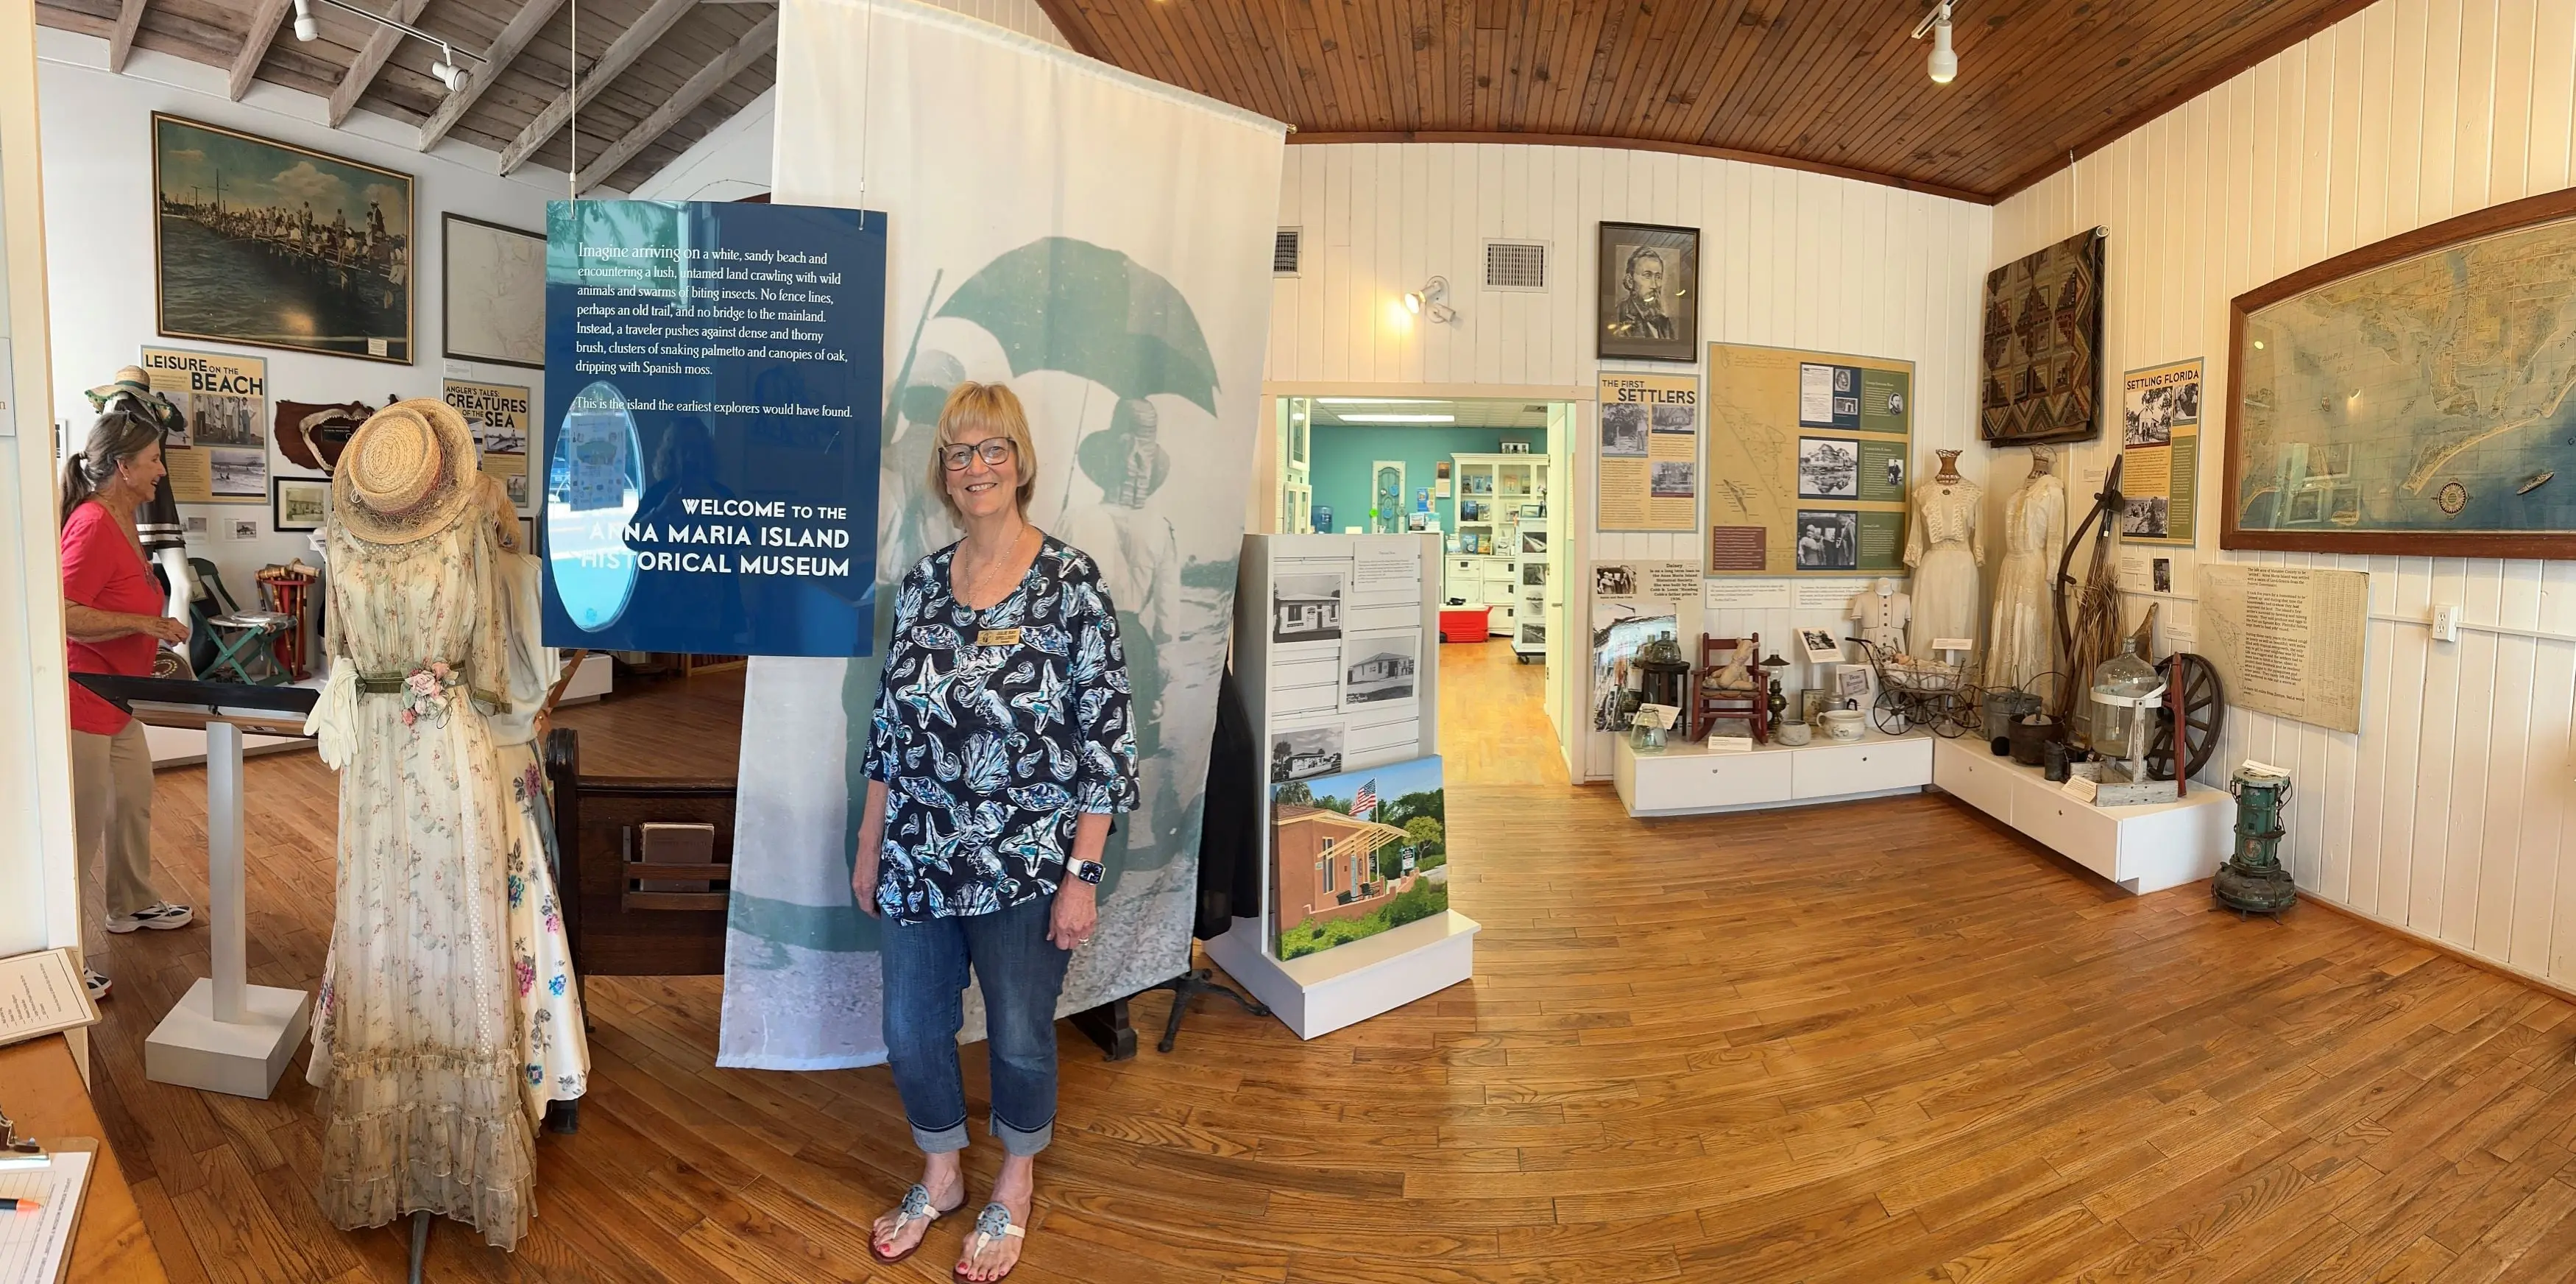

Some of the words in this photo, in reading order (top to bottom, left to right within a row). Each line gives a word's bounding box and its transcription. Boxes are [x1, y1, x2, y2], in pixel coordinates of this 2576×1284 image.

[578, 242, 629, 261] Imagine
[631, 244, 681, 262] arriving
[683, 248, 700, 258] on
[703, 251, 709, 260] a
[711, 249, 742, 261] white,
[744, 249, 774, 264] sandy
[776, 250, 807, 263] beach
[808, 253, 827, 264] and
[577, 266, 643, 279] encountering
[645, 266, 651, 277] a
[653, 266, 677, 278] lush,
[680, 268, 724, 279] untamed
[726, 268, 748, 279] land
[750, 270, 793, 285] crawling
[795, 271, 817, 283] with
[819, 272, 841, 284] wild
[577, 286, 615, 296] animals
[617, 286, 636, 296] and
[638, 288, 676, 297] swarms
[678, 287, 690, 297] of
[691, 287, 719, 301] biting
[721, 288, 758, 299] insects.
[760, 289, 776, 300] No
[778, 289, 806, 301] fence
[808, 290, 834, 304] lines,
[576, 303, 616, 317] perhaps
[632, 304, 649, 315] old
[651, 305, 674, 318] trail,
[675, 305, 695, 317] and
[697, 309, 710, 317] no
[712, 307, 745, 321] bridge
[747, 308, 757, 319] to
[759, 308, 775, 319] the
[777, 309, 826, 322] mainland.
[576, 322, 614, 335] Instead,
[625, 324, 663, 335] traveler
[664, 325, 699, 338] pushes
[701, 326, 736, 339] against
[738, 326, 768, 338] dense
[769, 328, 788, 339] and
[791, 328, 823, 343] thorny
[576, 341, 606, 354] brush,
[608, 342, 645, 353] clusters
[648, 343, 659, 354] of
[660, 344, 699, 358] snaking
[701, 345, 745, 358] palmetto
[747, 346, 766, 357] and
[768, 349, 812, 361] canopies
[814, 348, 825, 360] of
[826, 349, 848, 362] oak,
[2318, 352, 2344, 363] TAMPA
[146, 354, 207, 372] LEISURE
[223, 367, 239, 375] THE
[575, 360, 616, 374] dripping
[618, 361, 640, 372] with
[642, 361, 682, 375] Spanish
[684, 366, 712, 374] moss.
[192, 372, 263, 396] BEACH
[2127, 375, 2162, 390] SETTLING
[2164, 369, 2199, 384] FLORIDA
[446, 385, 477, 395] ANGLER'S
[479, 389, 500, 398] TALES:
[1618, 388, 1695, 404] SETTLERS
[446, 393, 527, 413] CREATURES
[576, 397, 597, 409] This
[599, 398, 607, 408] is
[609, 398, 625, 409] the
[627, 398, 656, 411] island
[658, 399, 674, 410] the
[676, 400, 712, 411] earliest
[713, 401, 760, 415] explorers
[762, 403, 793, 414] would
[796, 404, 819, 415] have
[821, 404, 853, 417] found.
[485, 411, 515, 428] SEA
[681, 499, 785, 517] WELCOME
[791, 506, 812, 518] TO
[817, 507, 846, 519] THE
[589, 523, 659, 542] ANNA
[668, 525, 751, 544] MARIA
[761, 528, 849, 548] ISLAND
[580, 551, 732, 573] HISTORICAL
[740, 556, 849, 576] MUSEUM
